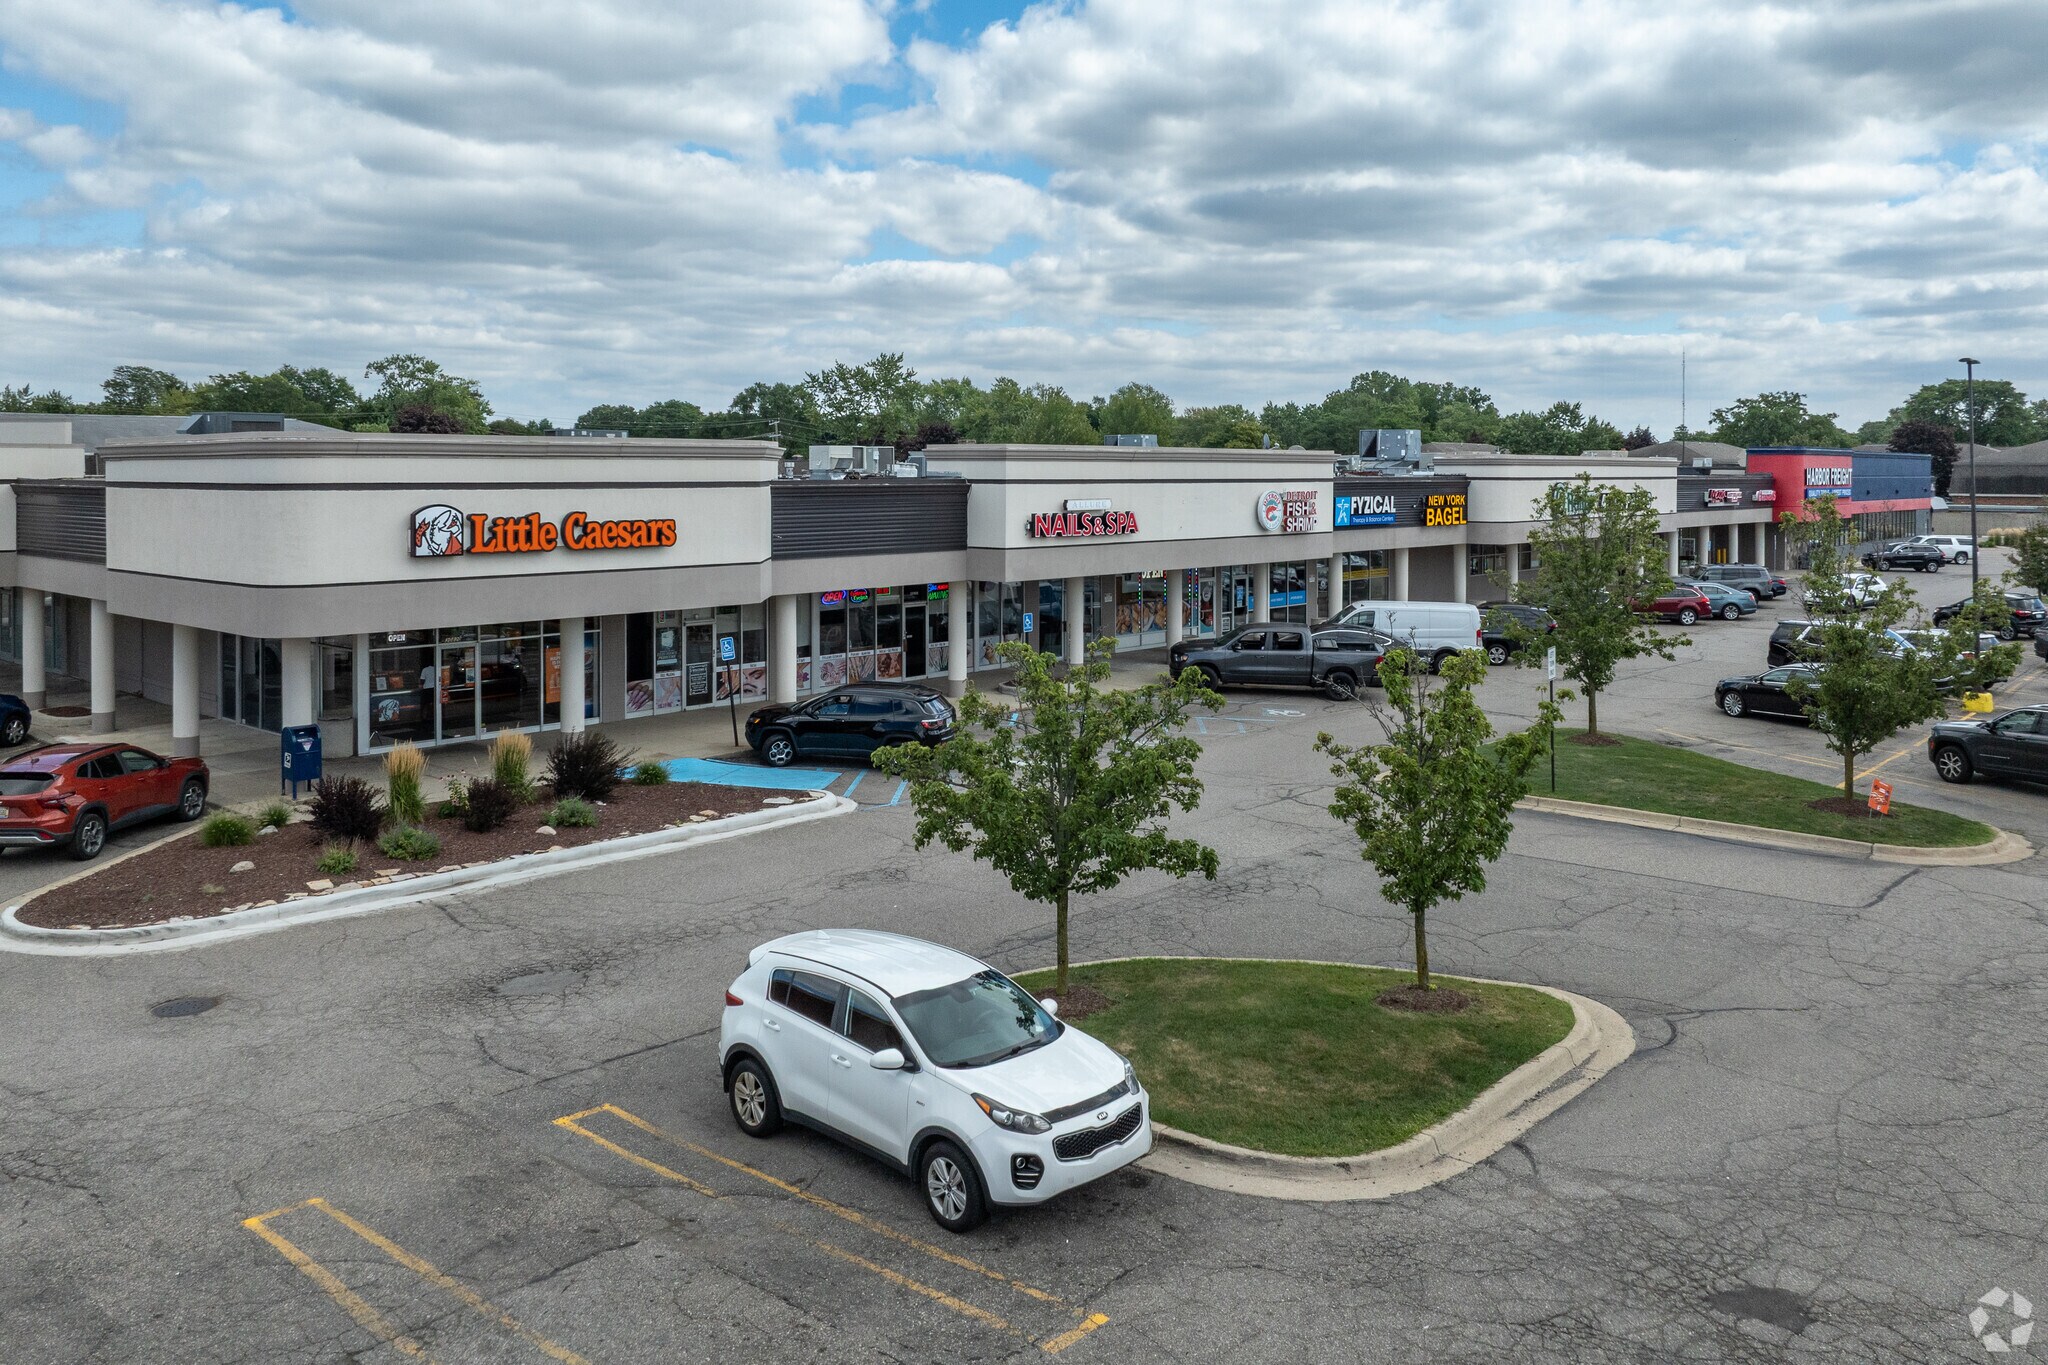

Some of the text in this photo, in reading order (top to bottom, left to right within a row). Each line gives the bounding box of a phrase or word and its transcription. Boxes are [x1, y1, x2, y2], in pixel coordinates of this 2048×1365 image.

[1806, 467, 1852, 486] HARBOR FREIGHT
[1286, 490, 1318, 500] DETROIT
[1428, 494, 1466, 506] NEW YORK
[1072, 500, 1108, 509] ALLURE
[1286, 501, 1309, 516] FISH
[1350, 495, 1396, 514] FYZICAL
[1352, 516, 1365, 524] Therapy
[1426, 507, 1467, 526] BAGEL
[1286, 517, 1317, 532] SHRIMP
[469, 511, 677, 554] Little Caesars
[823, 591, 843, 602] OPEN
[388, 633, 406, 642] OPEN
[1097, 1111, 1108, 1120] KIA
